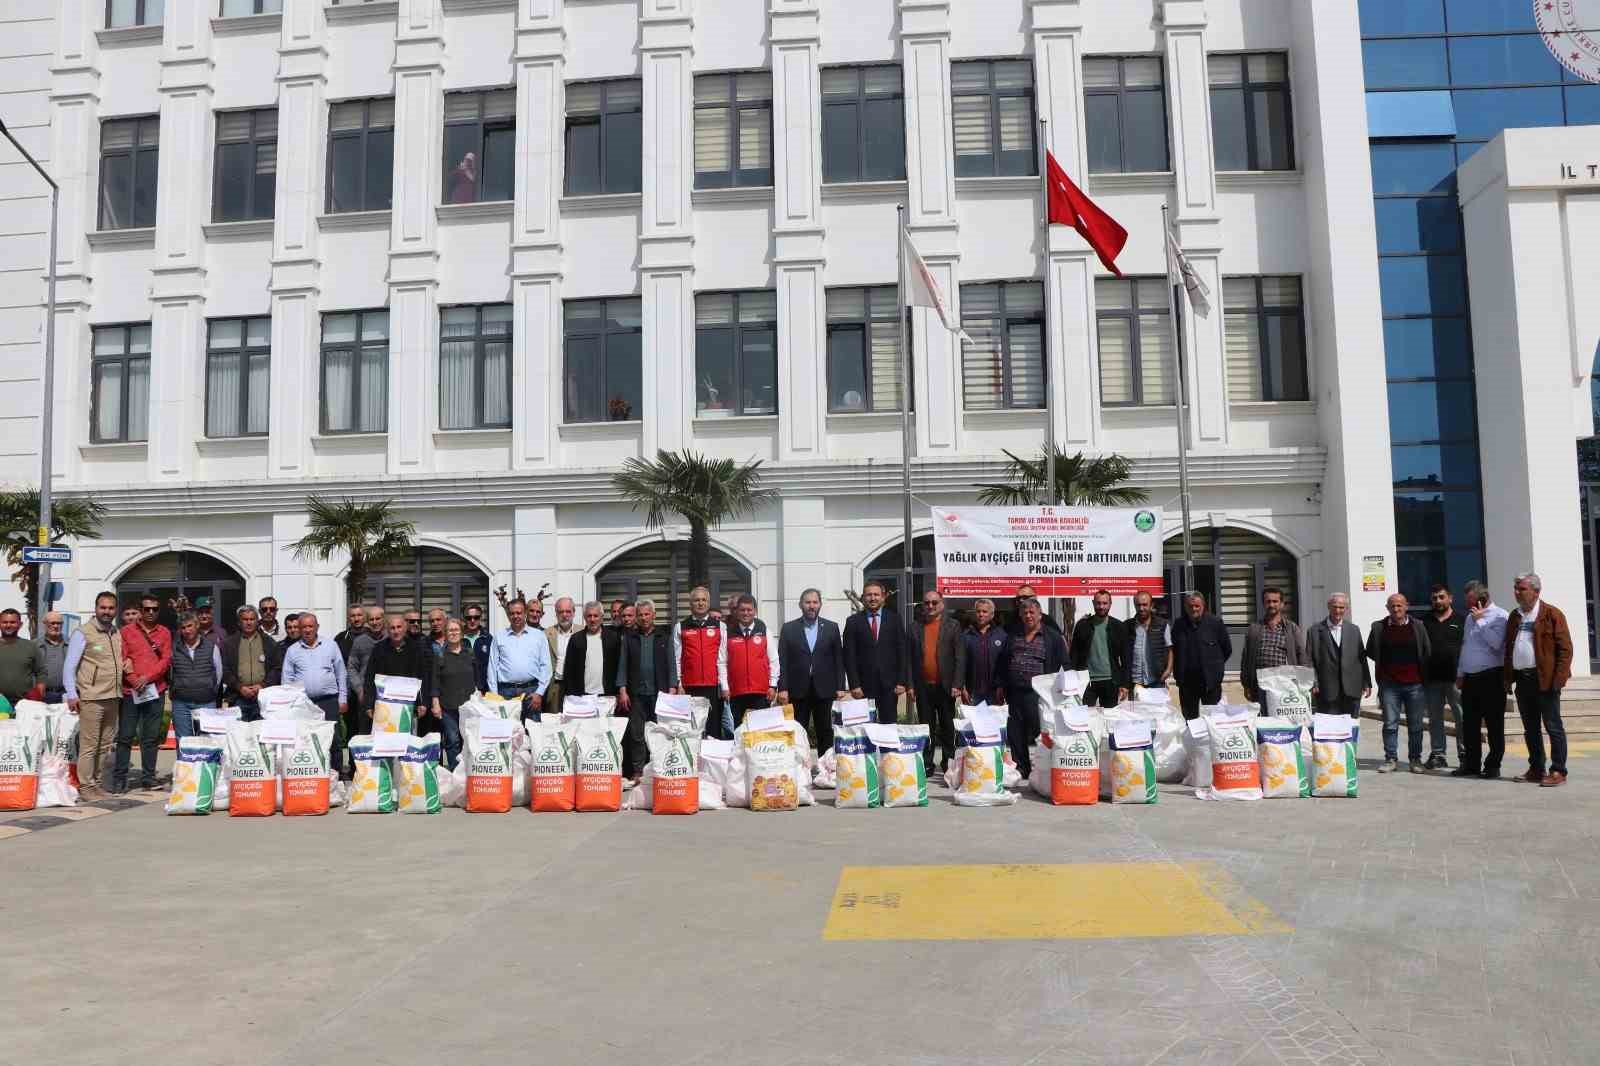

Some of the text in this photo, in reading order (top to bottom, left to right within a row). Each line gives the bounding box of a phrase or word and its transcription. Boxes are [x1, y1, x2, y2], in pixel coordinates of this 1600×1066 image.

[1014, 540, 1084, 551] YALOVA İLİNDE
[943, 551, 977, 562] YAĞLIK
[980, 551, 1024, 565] AYÇİÇEĞİ
[1027, 551, 1084, 562] ÜRETİMİNİN
[1029, 563, 1070, 575] PROJESİ
[1276, 707, 1307, 716] PIONEER
[1218, 751, 1253, 761] PIONEER
[1060, 757, 1093, 767] PIONEER
[287, 767, 319, 777] PIONEER
[472, 765, 504, 774] PIONEER
[534, 765, 565, 774] PIONEER
[582, 763, 613, 772] PIONEER
[232, 769, 264, 778] PIONEER
